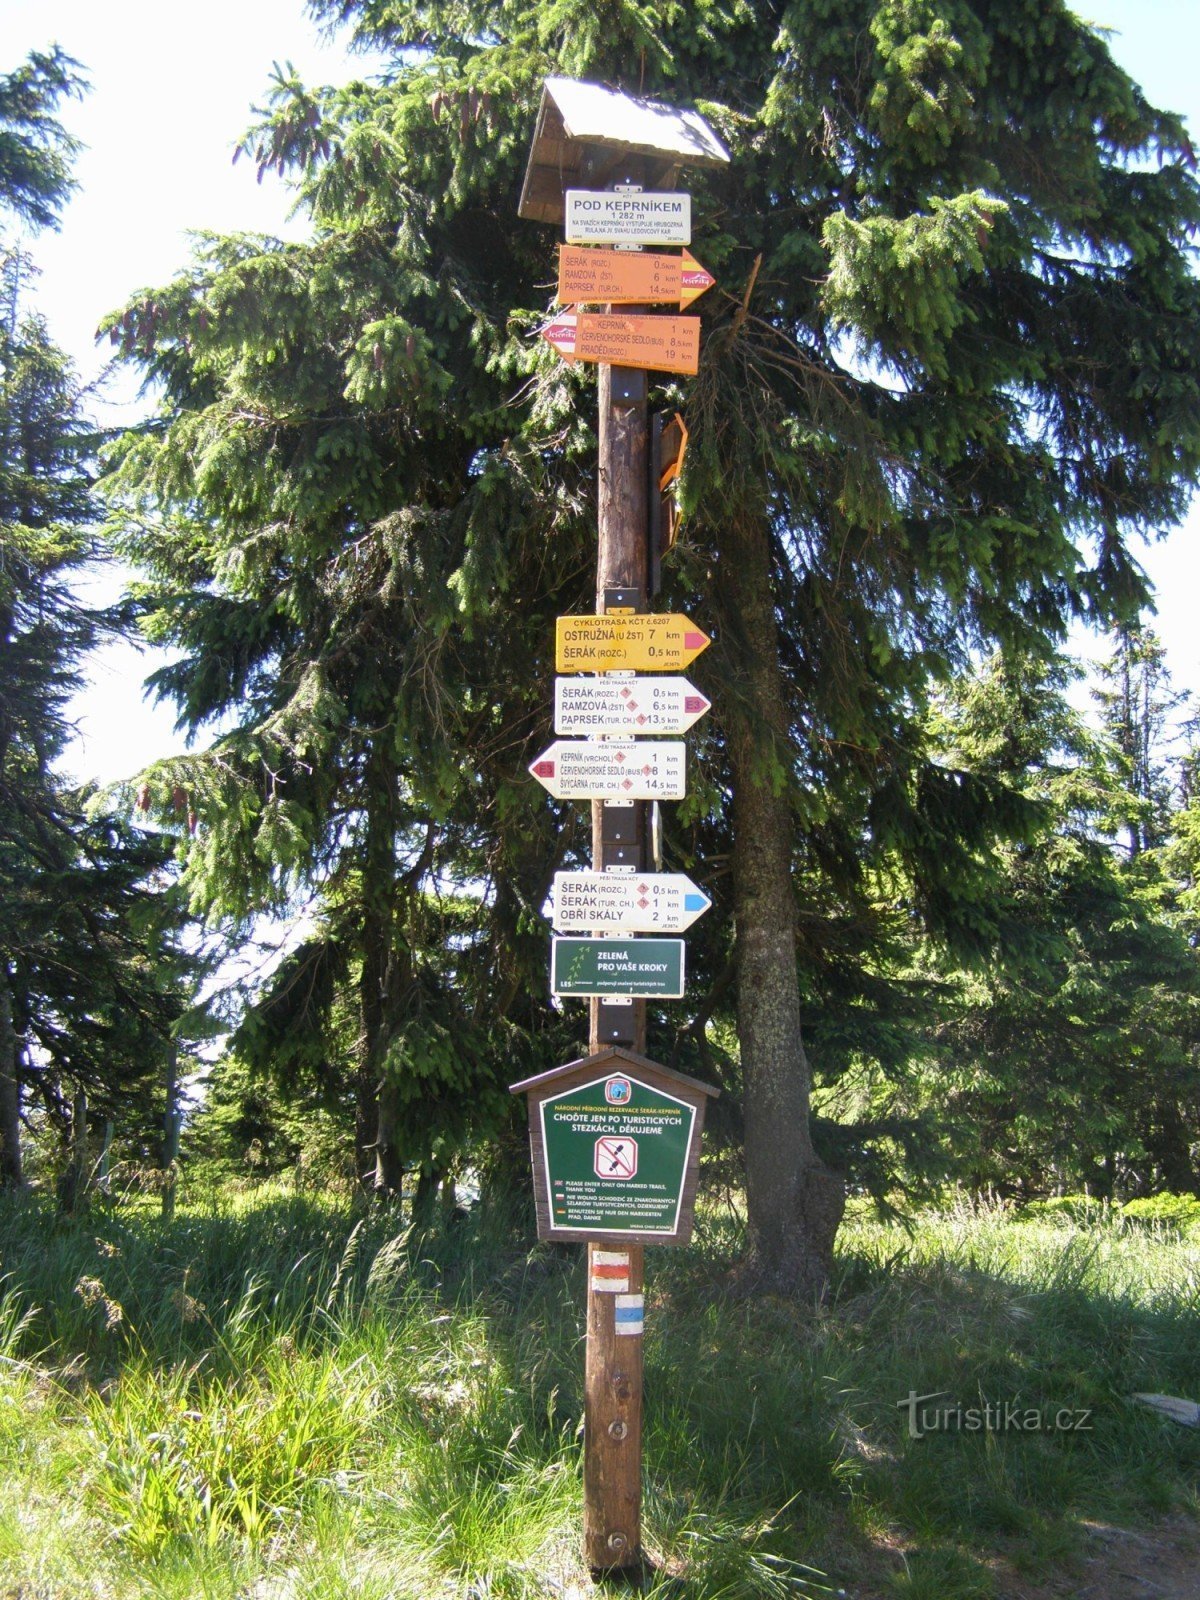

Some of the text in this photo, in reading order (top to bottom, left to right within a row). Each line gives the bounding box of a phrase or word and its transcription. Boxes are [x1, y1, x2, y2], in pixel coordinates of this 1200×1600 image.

[574, 200, 681, 212] POD KEPRNÍKEM
[566, 256, 587, 266] ŠERÁK
[565, 268, 596, 280] RAMZOVÁ
[565, 283, 594, 291] PAPRSEK
[598, 320, 626, 330] KEPRNÍK
[582, 331, 630, 343] ČERVENOHORSKÉ
[632, 334, 650, 344] SEDLO
[581, 344, 608, 354] PRADĚD
[665, 350, 675, 359] 19
[564, 628, 615, 641] OSTRUŽNÁ
[616, 632, 624, 641] (U
[626, 630, 644, 641] ŽST)
[649, 629, 656, 639] 7
[564, 646, 596, 658] ŠERÁK
[598, 649, 627, 658] (ROZC.)
[648, 647, 663, 657] 0,5
[562, 687, 594, 698] ŠERÁK
[653, 689, 666, 698] 0,5
[562, 700, 607, 711] RAMZOVÁ
[609, 703, 624, 711] (ŽST)
[653, 702, 666, 711] 6,5
[562, 715, 604, 724] PAPRSEK
[561, 751, 583, 761] KEPRNÍK
[584, 755, 614, 763] (VRCHOL)
[652, 754, 657, 762] 1
[560, 765, 606, 775] ČERVENOHORSKÉ
[608, 767, 624, 775] SEDLO
[652, 767, 658, 776] 8
[560, 779, 588, 789] ŠVÝCÁRNA
[645, 780, 664, 790] 14,5
[562, 882, 597, 893] ŠERÁK
[653, 885, 665, 895] 0,5
[561, 896, 597, 906] ŠERÁK
[653, 899, 658, 907] 1
[560, 909, 586, 920] OBŘÍ
[590, 910, 624, 920] SKÁLY
[653, 912, 659, 921] 2
[598, 951, 628, 960] ZELENÁ
[616, 962, 637, 971] VAŠE
[554, 1113, 588, 1122] CHOĎTE
[623, 1116, 682, 1125] TURISTICKÝCH
[572, 1124, 663, 1134] STEZKÁCH, DĚKUJEME
